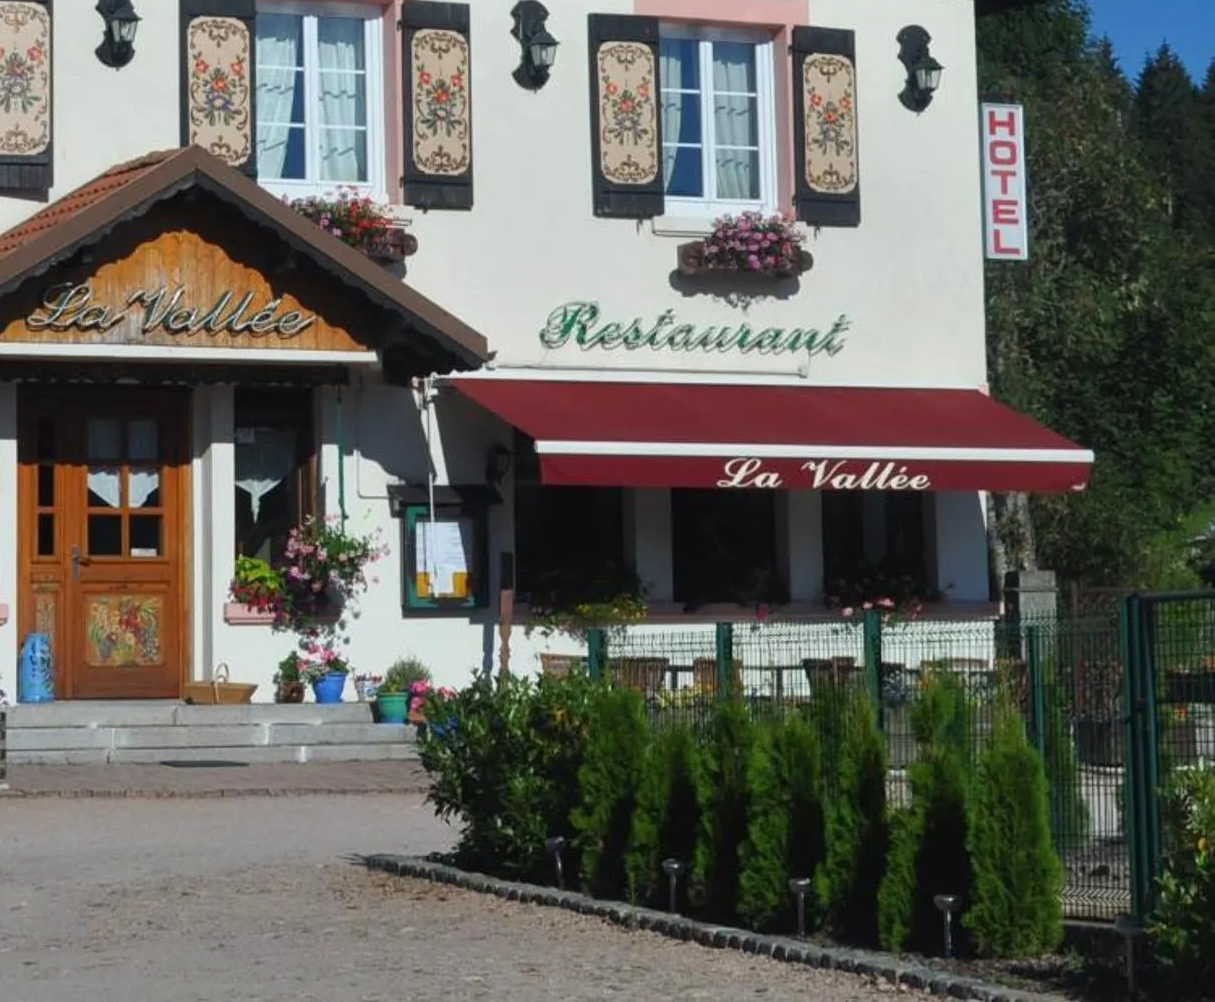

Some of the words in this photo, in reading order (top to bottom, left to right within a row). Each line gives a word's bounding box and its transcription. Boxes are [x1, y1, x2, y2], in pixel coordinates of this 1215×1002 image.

[988, 109, 1022, 256] HOTEL
[25, 281, 125, 332] La
[125, 283, 317, 339] Vallée
[538, 300, 854, 357] Restaurant
[716, 456, 784, 489] La
[799, 459, 932, 491] Vallée
